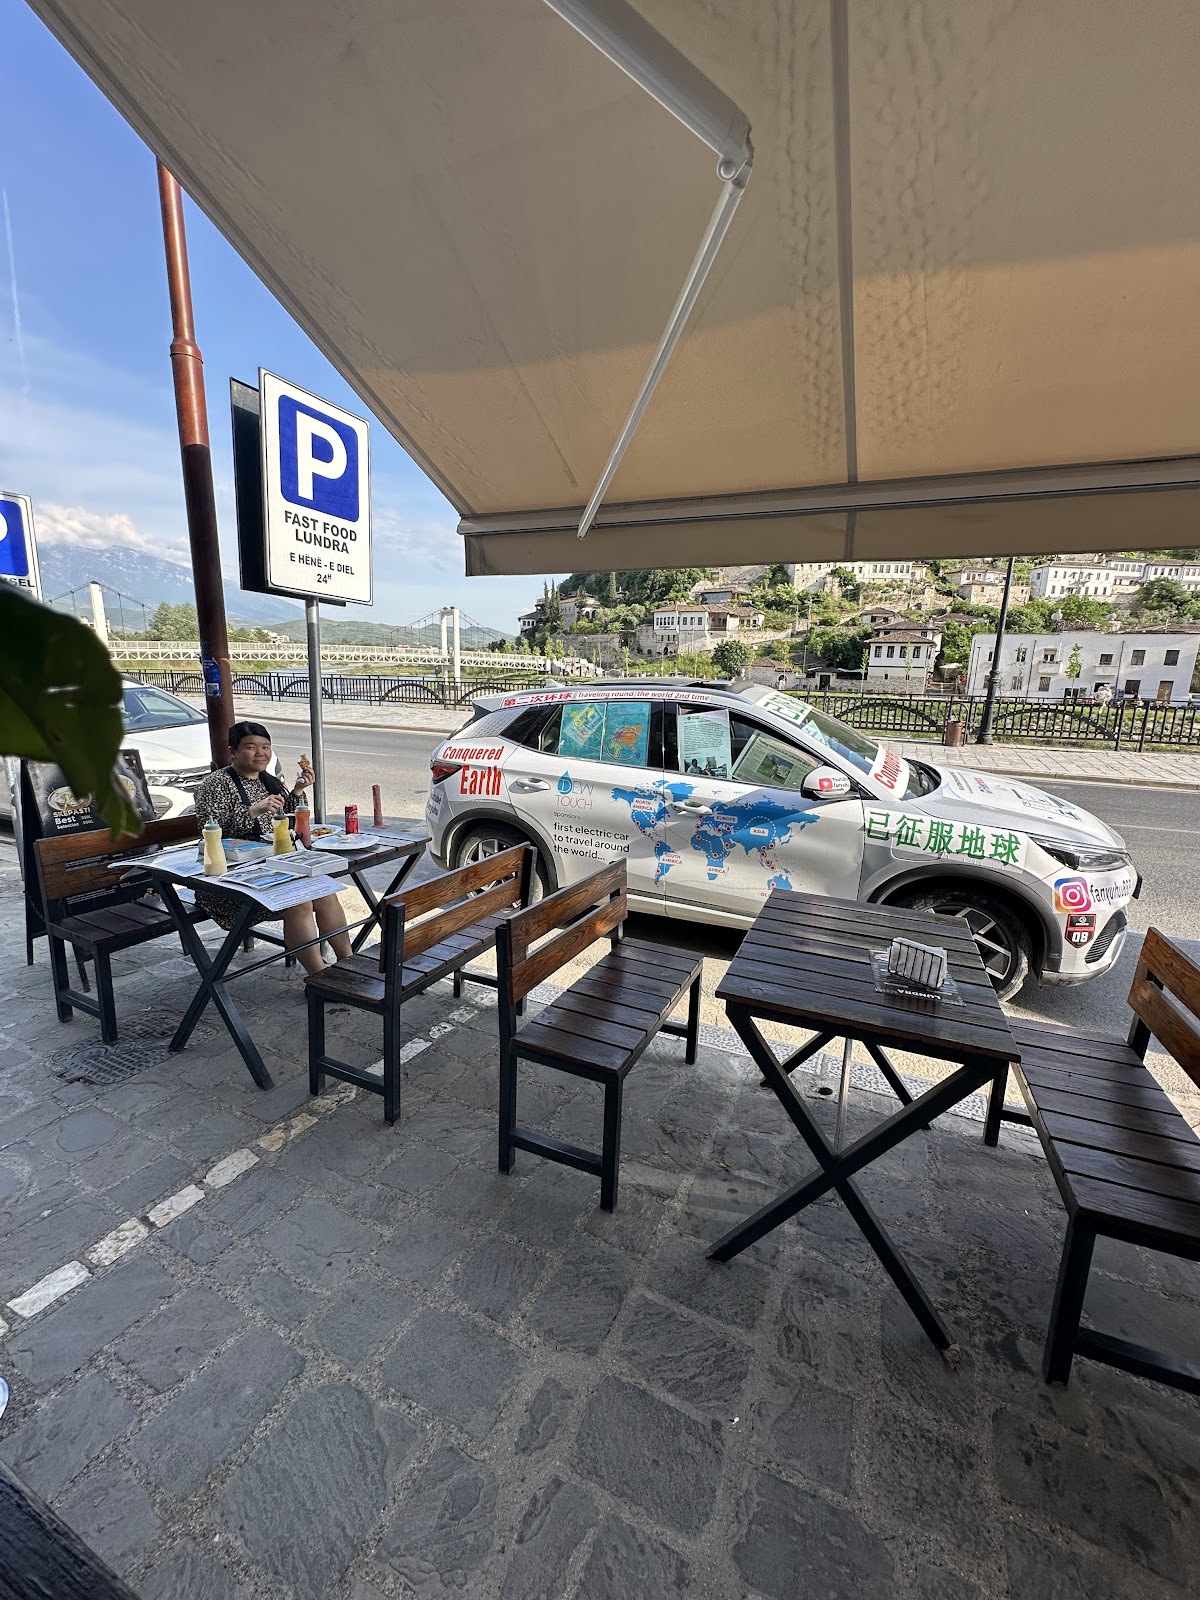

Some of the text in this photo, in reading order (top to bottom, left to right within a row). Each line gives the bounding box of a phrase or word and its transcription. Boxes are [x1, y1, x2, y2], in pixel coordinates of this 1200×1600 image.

[296, 410, 348, 500] P
[284, 509, 357, 542] FAST FOOD
[295, 528, 350, 554] LUNDRA
[289, 552, 296, 562] E
[298, 553, 323, 568] HËNË
[329, 561, 335, 571] E
[336, 563, 355, 575] DIEL
[5, 577, 35, 588] SEL
[442, 745, 505, 762] Conquered
[460, 764, 502, 796] Earth
[558, 778, 595, 796] DEW
[555, 794, 593, 811] TOUCH
[52, 806, 91, 818] SKEPASTI
[54, 815, 77, 825] Best
[553, 811, 581, 820] sponsors
[716, 815, 737, 823] EUROPE
[56, 822, 80, 830] Selection
[553, 821, 629, 841] first electric car
[553, 833, 630, 853] to travel around
[866, 810, 1022, 867] 已征服地球
[553, 844, 606, 861] the world...
[661, 857, 683, 865] AMERICA
[707, 867, 726, 875] AFRICA
